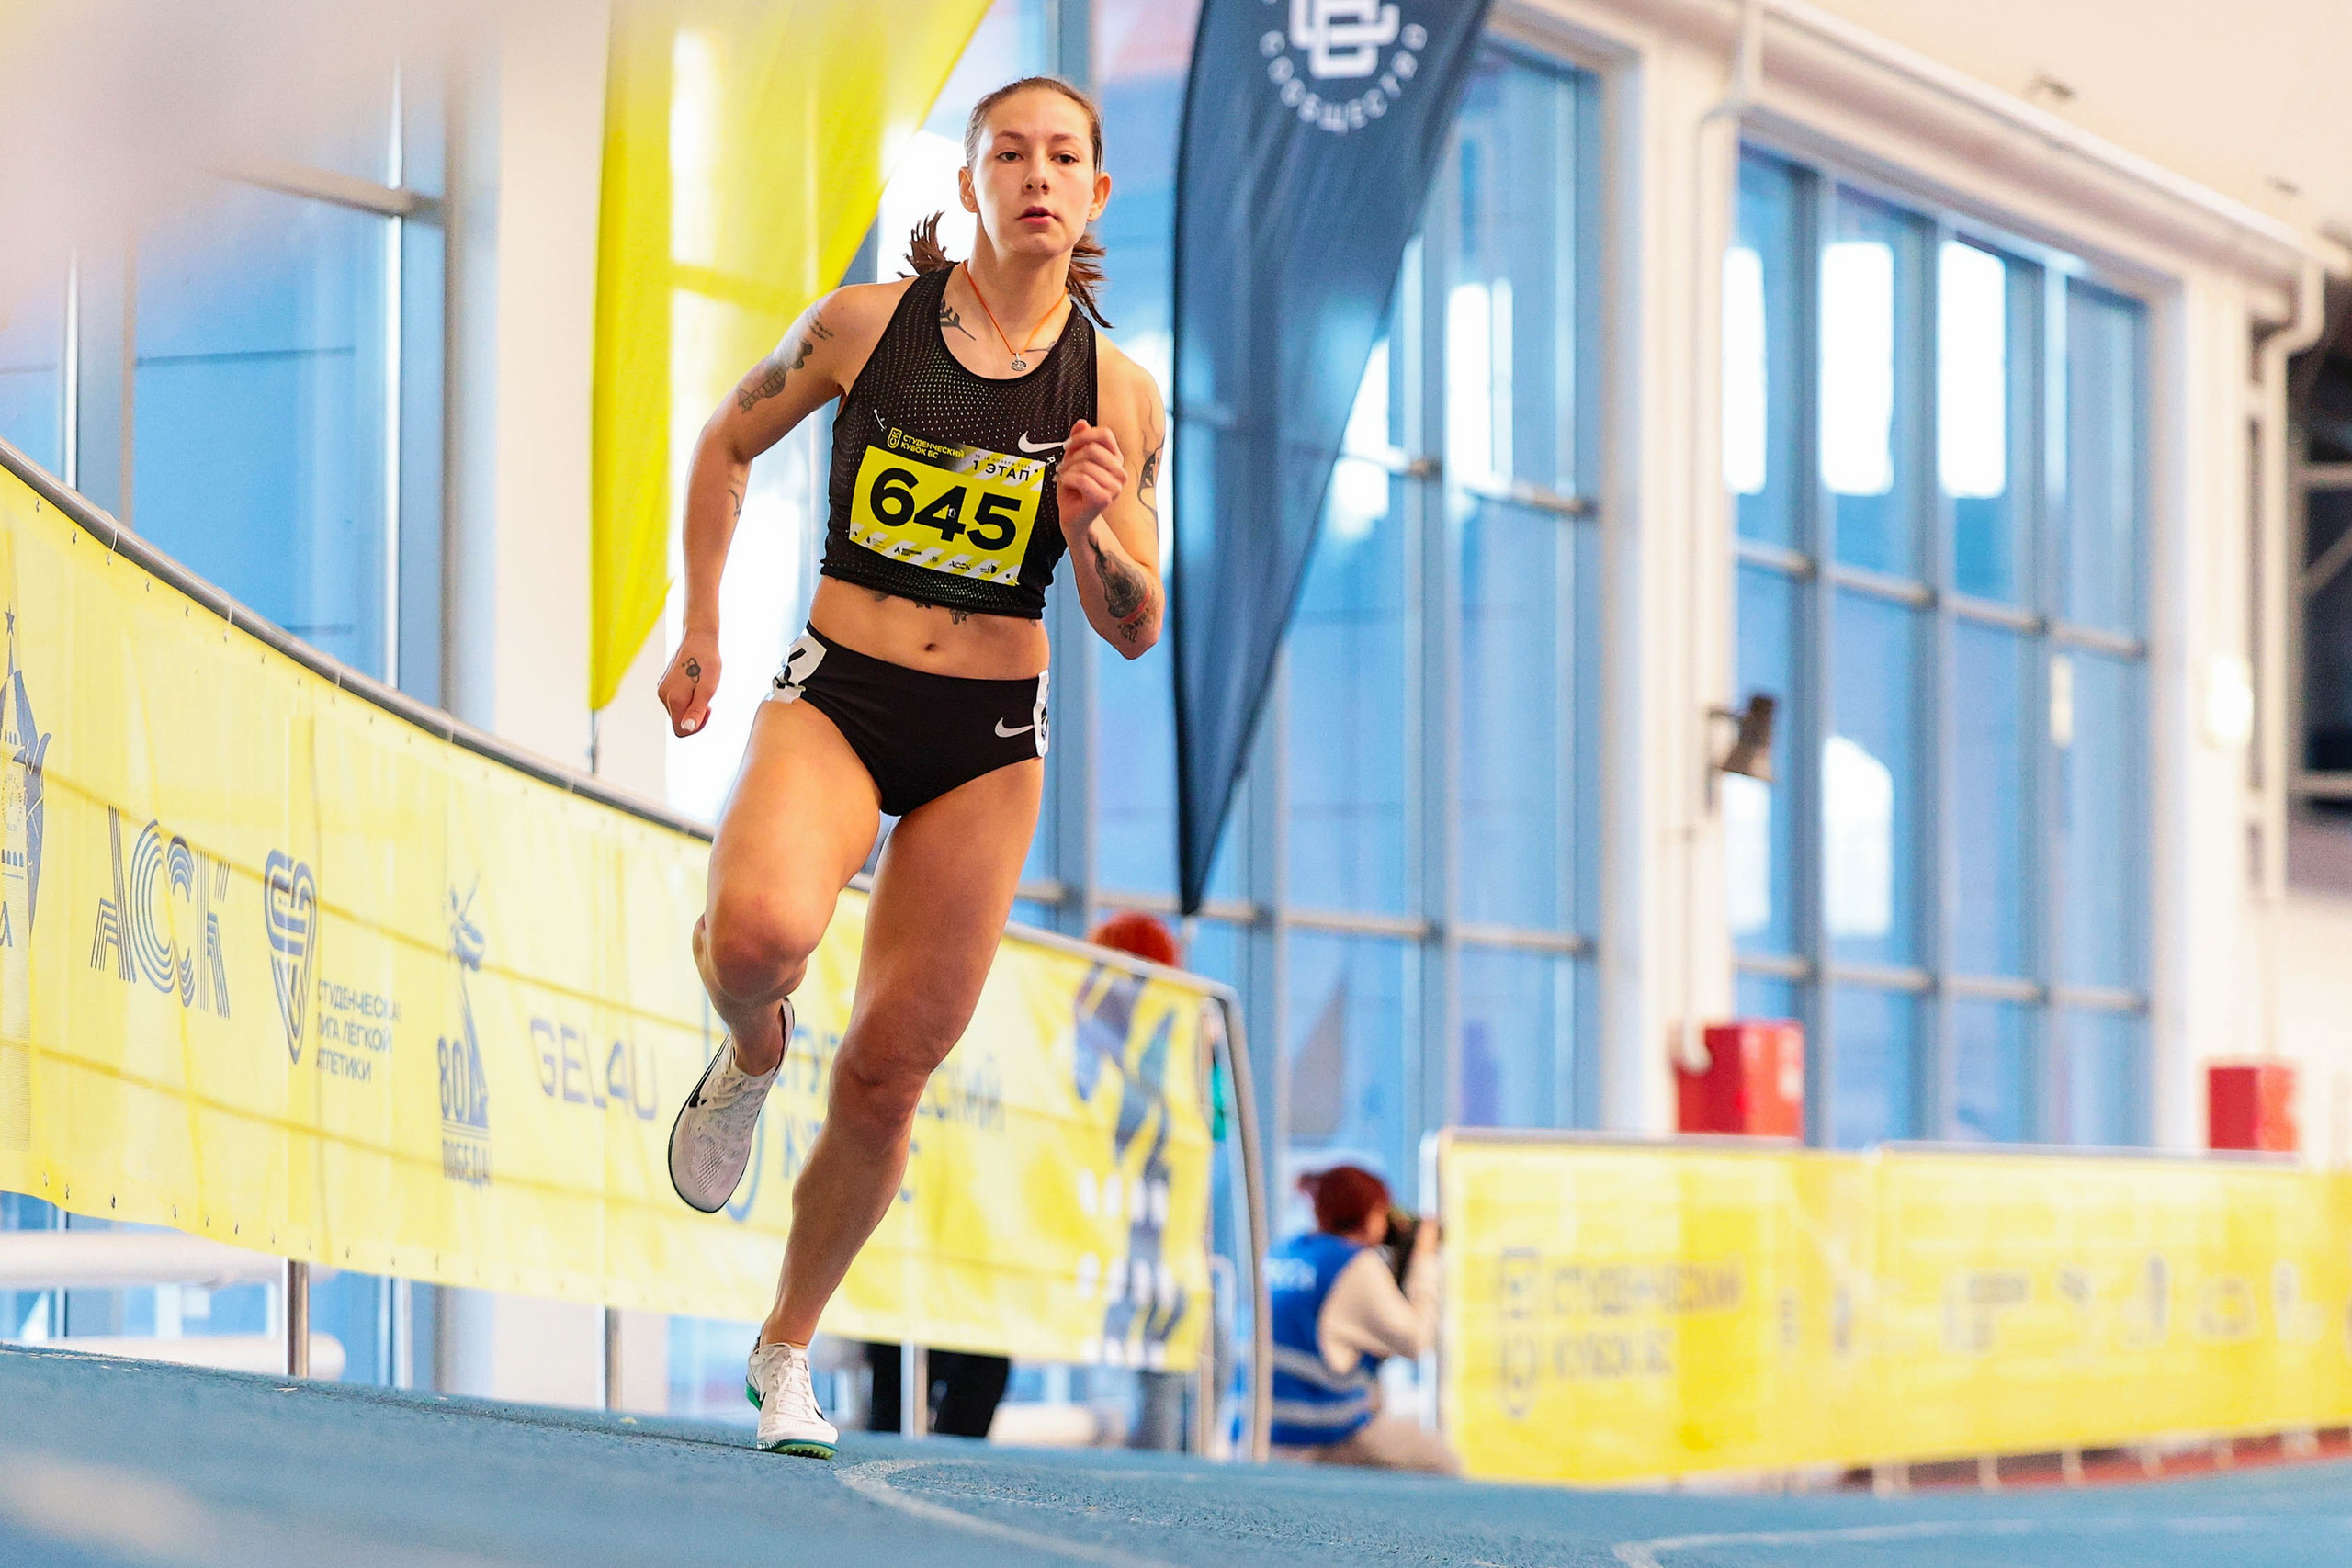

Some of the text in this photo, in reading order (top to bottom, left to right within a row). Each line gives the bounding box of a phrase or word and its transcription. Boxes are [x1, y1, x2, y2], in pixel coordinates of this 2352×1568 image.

[900, 442, 926, 456] КУБОК
[902, 434, 965, 458] СТУДЕНЧЕСКИЙ
[973, 460, 1030, 481] 1 ЭТАП
[869, 468, 1022, 551] 645
[530, 1018, 658, 1121] GEL4U
